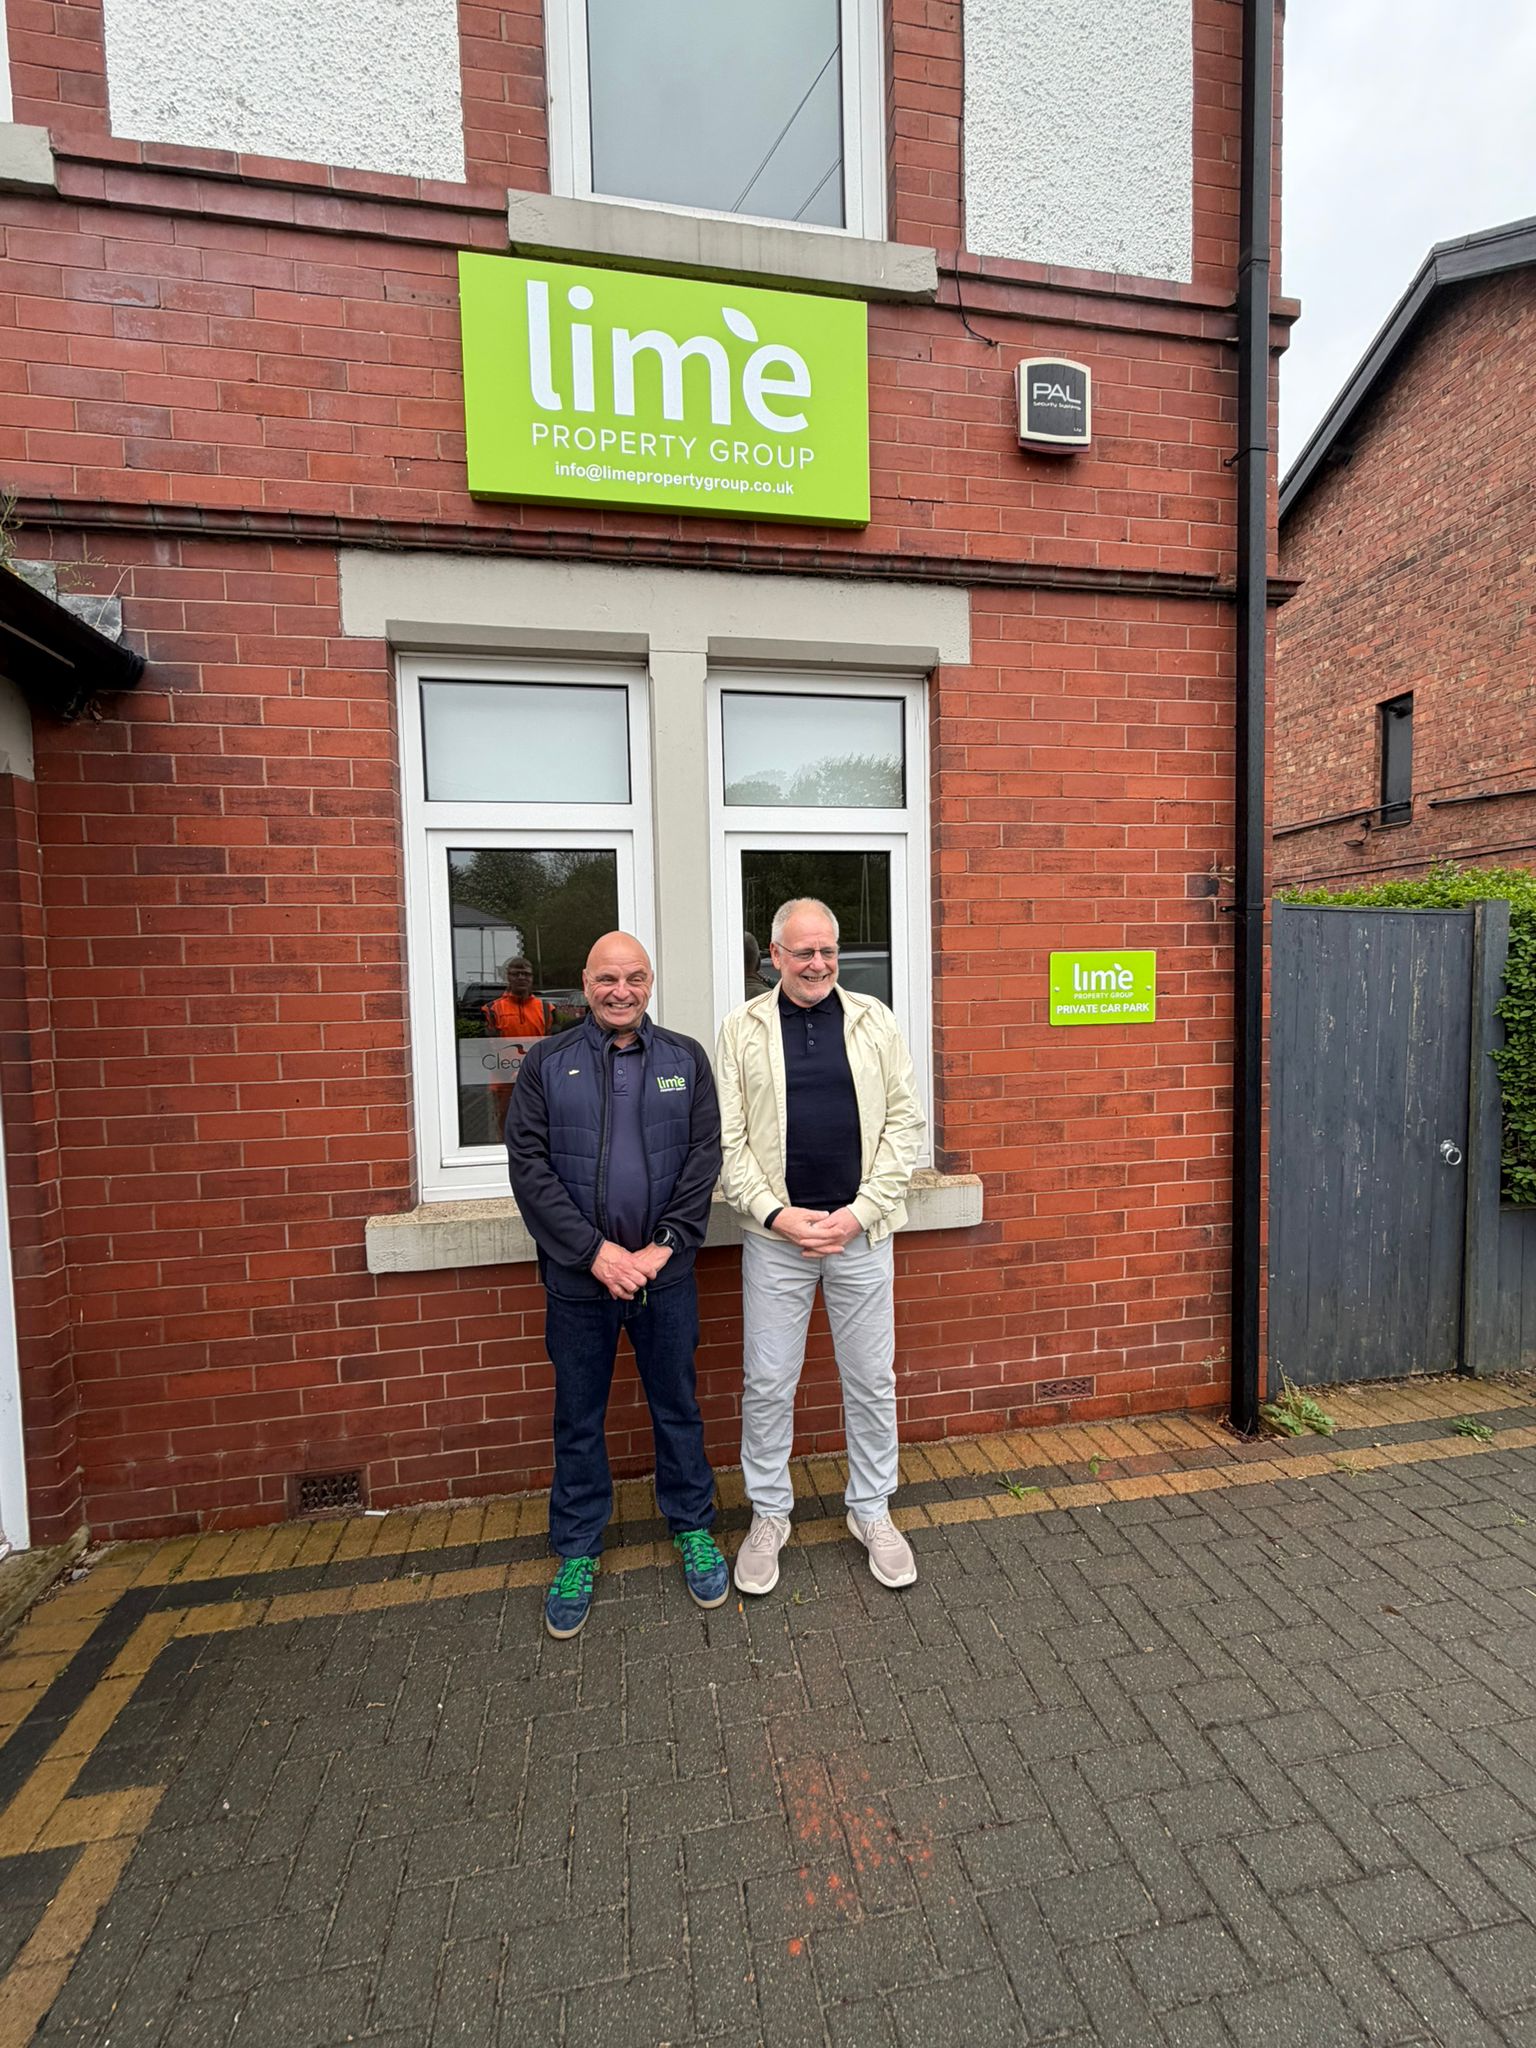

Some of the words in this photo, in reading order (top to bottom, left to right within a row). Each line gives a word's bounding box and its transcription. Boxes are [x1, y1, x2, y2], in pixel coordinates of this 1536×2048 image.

[526, 279, 812, 434] lime
[1033, 382, 1081, 405] PAL
[532, 422, 697, 460] PROPERTY
[709, 439, 815, 471] GROUP
[554, 461, 795, 496] info@limepropertygroup.co.uk
[1073, 962, 1134, 992] lime
[1056, 1004, 1098, 1014] PRIVATE
[1100, 1003, 1121, 1013] CAR
[1123, 1002, 1150, 1012] PARK
[1073, 992, 1109, 1000] PROPERTY
[1110, 991, 1134, 999] GROUP
[656, 1075, 686, 1089] lime
